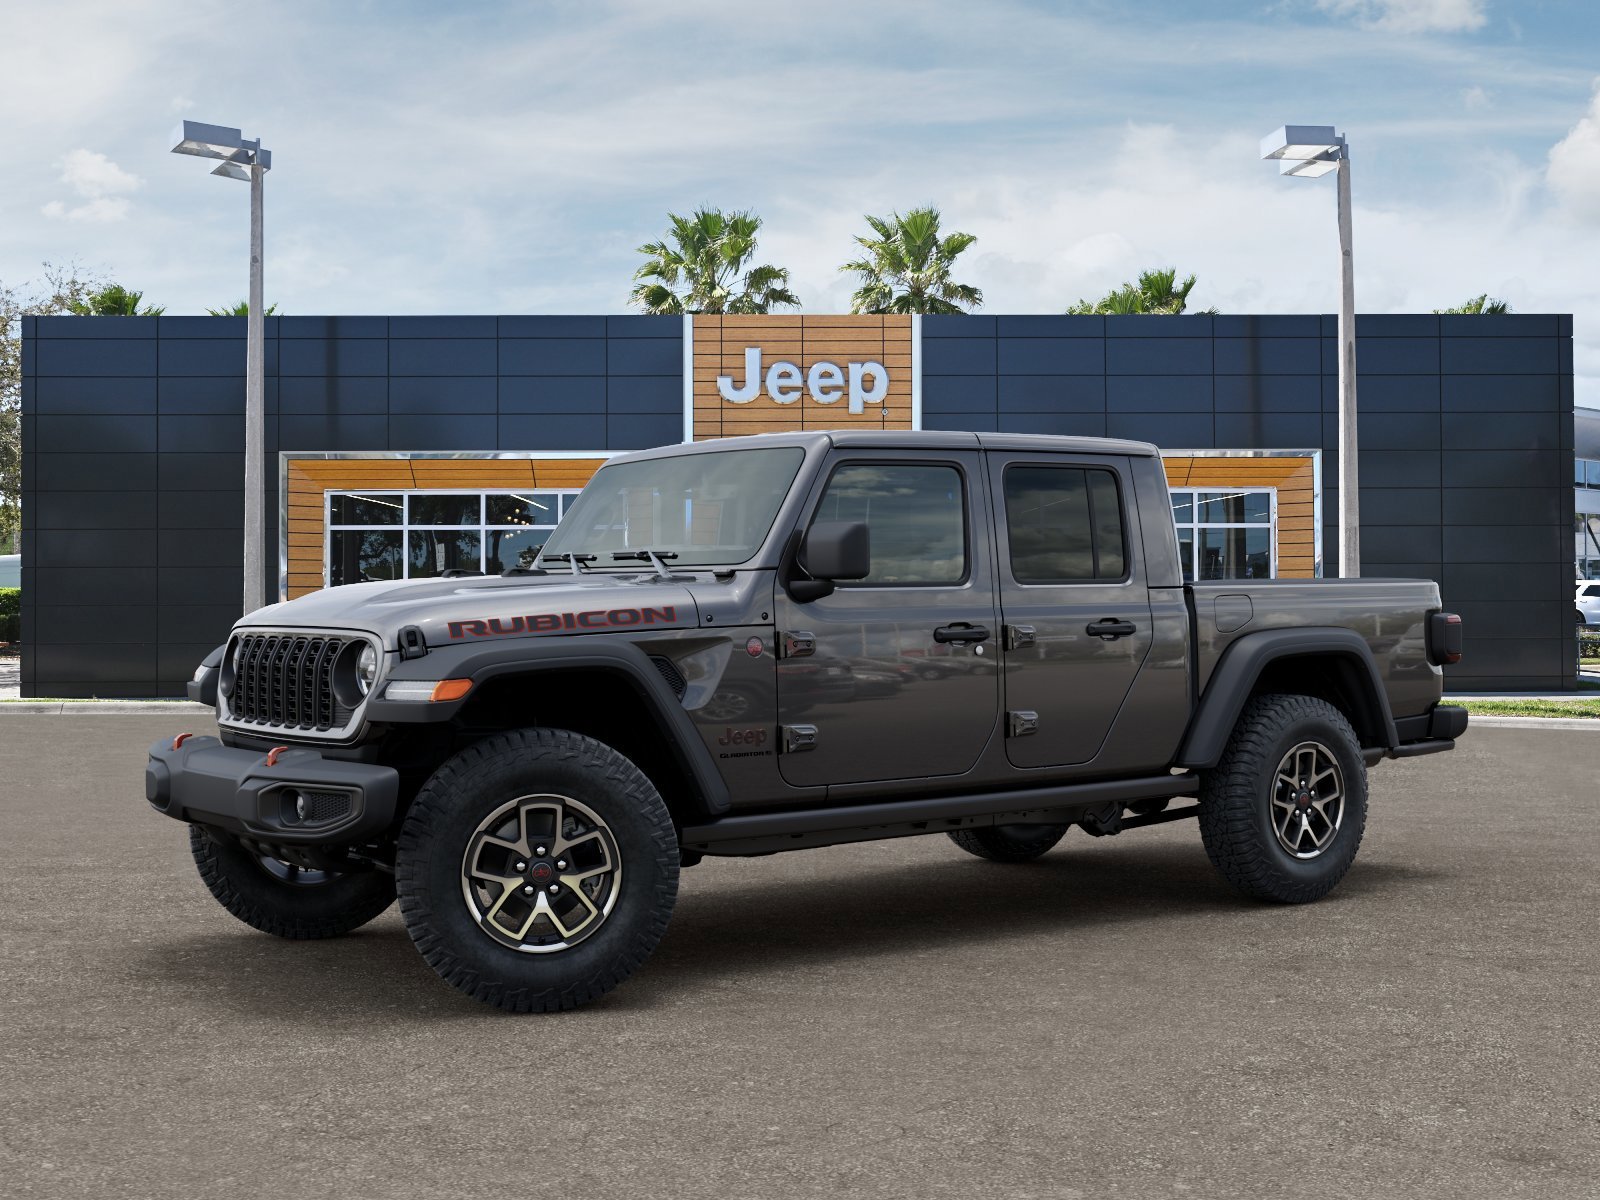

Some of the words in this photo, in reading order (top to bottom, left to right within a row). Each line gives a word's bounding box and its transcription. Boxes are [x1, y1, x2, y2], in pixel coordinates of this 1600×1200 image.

[717, 347, 889, 414] Jeep
[447, 606, 677, 639] RUBICON
[718, 726, 768, 747] Jeep
[719, 750, 765, 759] GLADIATOR
